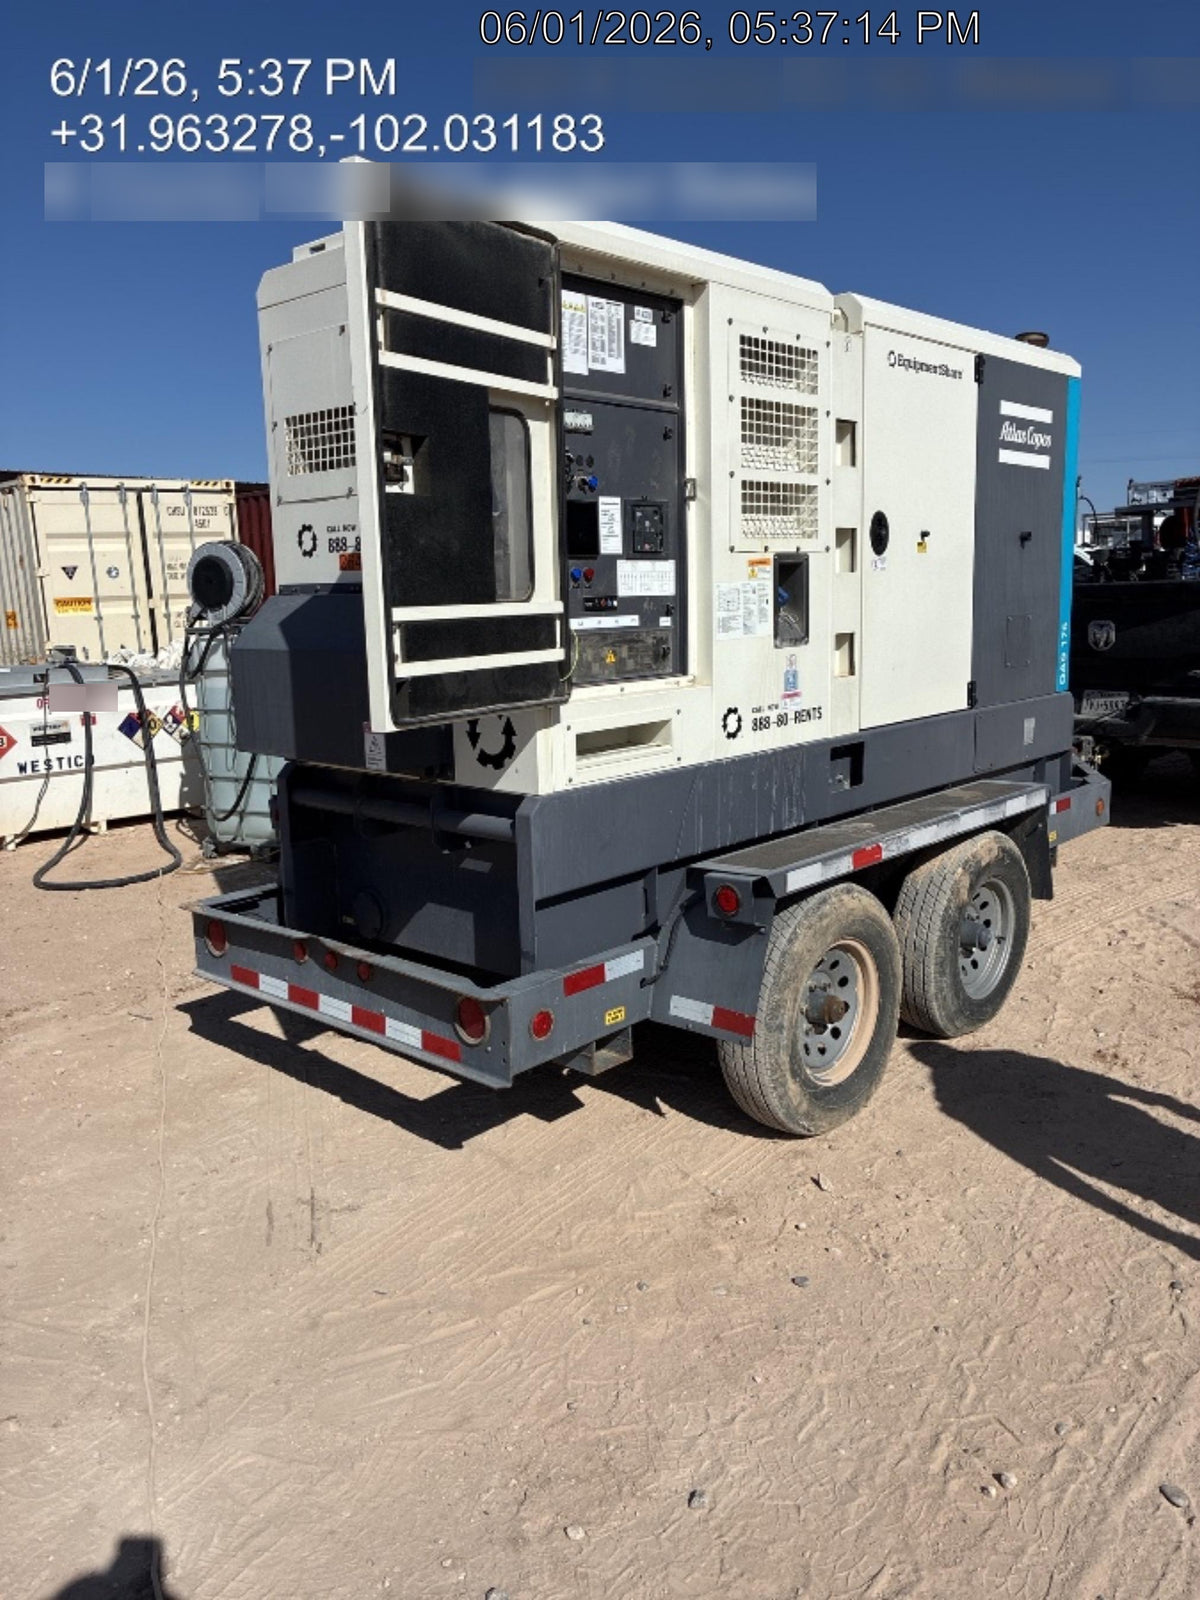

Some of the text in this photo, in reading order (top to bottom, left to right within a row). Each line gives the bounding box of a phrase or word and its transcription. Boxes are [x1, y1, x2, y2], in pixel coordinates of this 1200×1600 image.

[898, 353, 963, 379] EquipmentShare
[999, 421, 1051, 450] Atlas Copco
[752, 706, 823, 732] 888-80-RENTS
